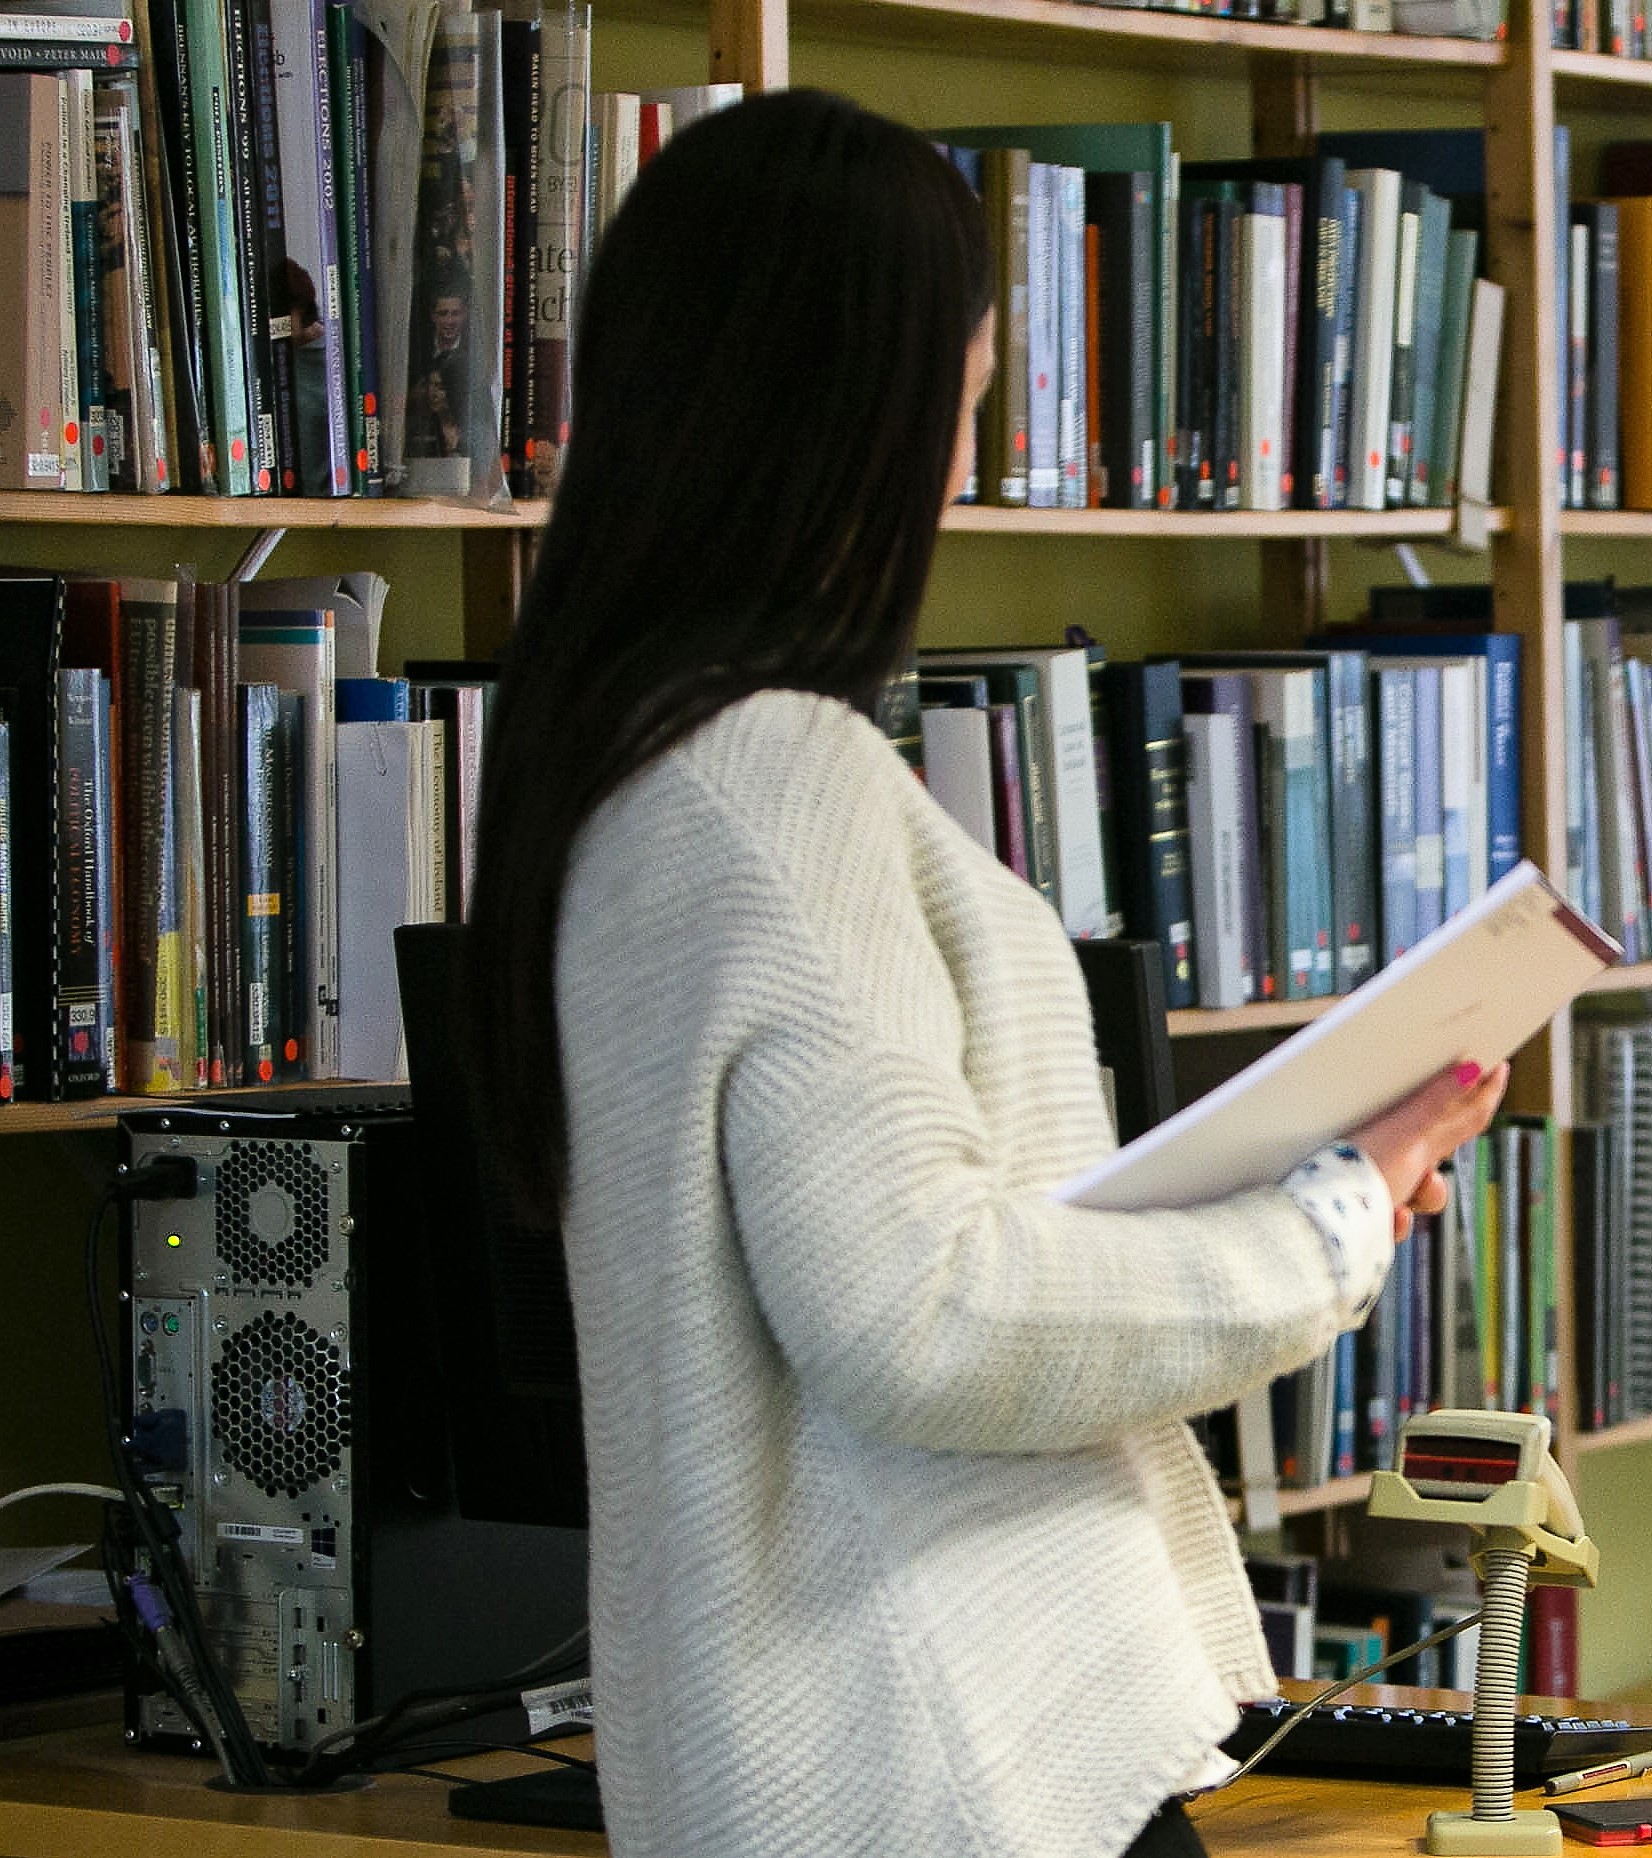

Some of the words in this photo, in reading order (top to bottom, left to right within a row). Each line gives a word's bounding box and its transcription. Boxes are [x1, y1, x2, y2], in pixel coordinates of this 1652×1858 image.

[178, 24, 189, 108] BRENNAN'S
[234, 9, 247, 123] ELECTIONS
[242, 129, 250, 159] '99
[531, 53, 540, 89] MALIN
[316, 30, 332, 151] ELECTIONS
[531, 93, 539, 123] HEAD
[183, 112, 191, 142] KEY
[531, 128, 539, 141] TO
[185, 148, 192, 167] TO
[530, 145, 539, 179] MIZEN
[186, 171, 195, 218] LOCAL
[264, 164, 281, 230] 2011
[323, 160, 334, 211] 2002
[529, 183, 538, 214] HEAD
[63, 216, 72, 255] Ireland
[244, 199, 253, 240] Kinds
[505, 175, 516, 270] International
[528, 247, 537, 280] KEVIN
[247, 261, 258, 337] Everything
[504, 273, 516, 323] affairs
[528, 284, 537, 324] RAFTER
[527, 379, 535, 424] WHELAN
[142, 618, 159, 699] possible
[284, 711, 296, 762] Economic
[433, 733, 444, 758] The
[69, 766, 81, 858] POLITICAL
[84, 780, 96, 805] The
[284, 766, 297, 836] Development
[432, 763, 444, 836] Economy
[84, 808, 97, 855] Oxford
[434, 840, 445, 858] of
[85, 858, 97, 927] Handbook
[433, 860, 445, 913] Ireland
[70, 865, 81, 955] ECONOMY
[84, 930, 96, 945] of
[71, 1006, 96, 1024] 330.9
[68, 1071, 102, 1084] OXFORD
